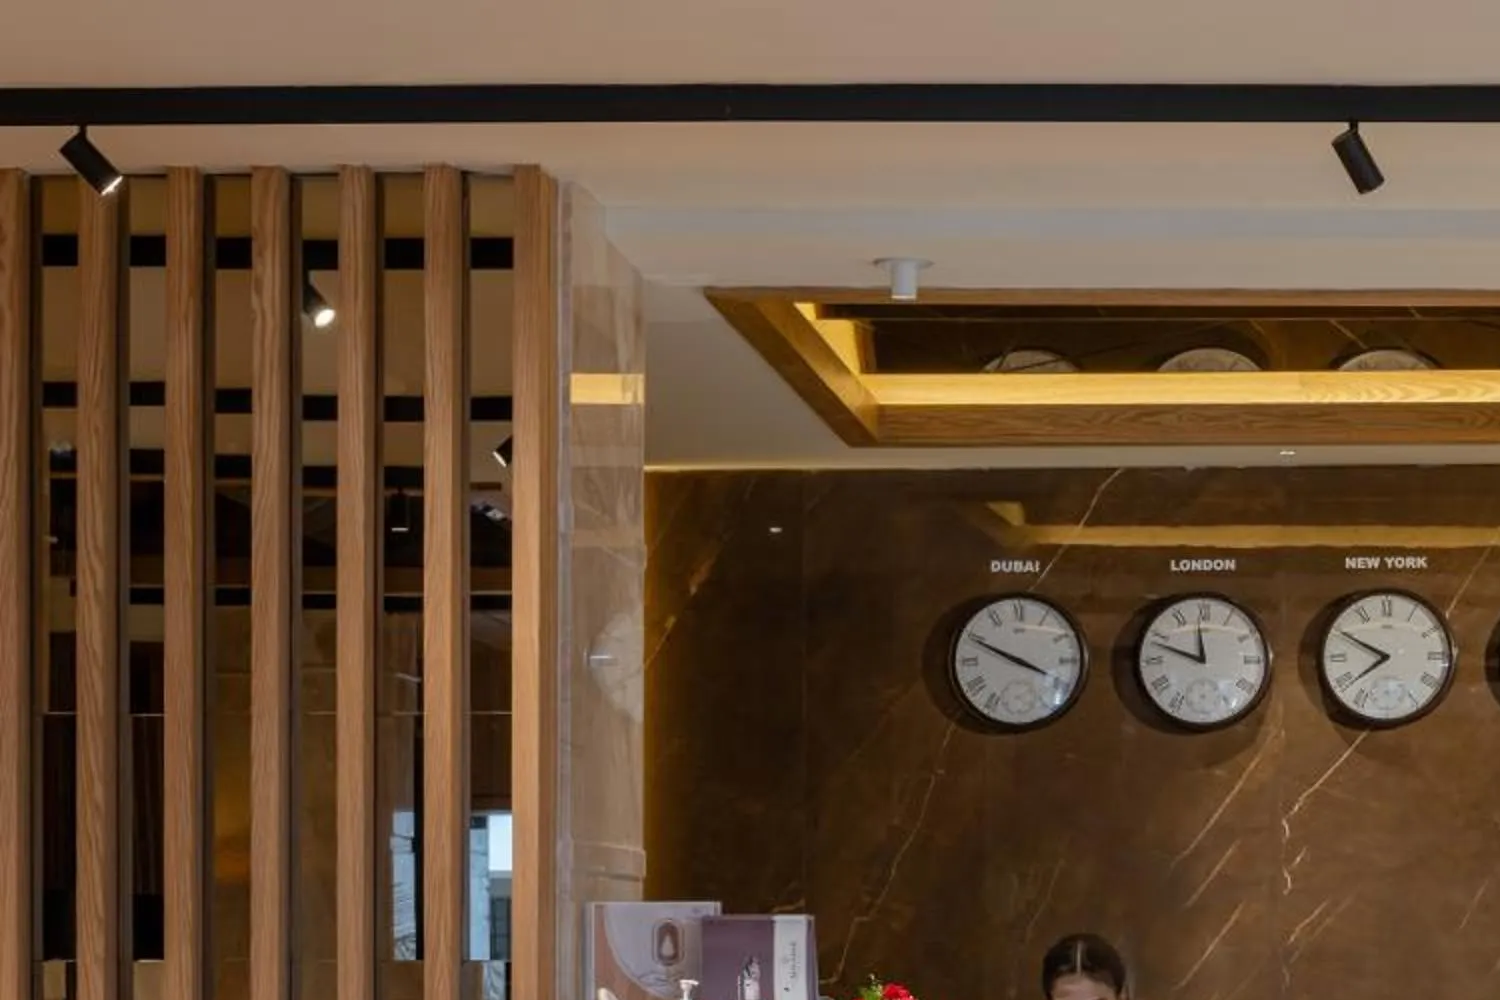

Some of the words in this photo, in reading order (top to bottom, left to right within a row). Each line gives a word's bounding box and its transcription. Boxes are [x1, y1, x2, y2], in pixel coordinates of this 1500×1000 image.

[989, 560, 1040, 573] DUBAI
[1170, 559, 1236, 572] LONDON
[1345, 556, 1381, 569] NEW
[1384, 556, 1428, 569] YORK
